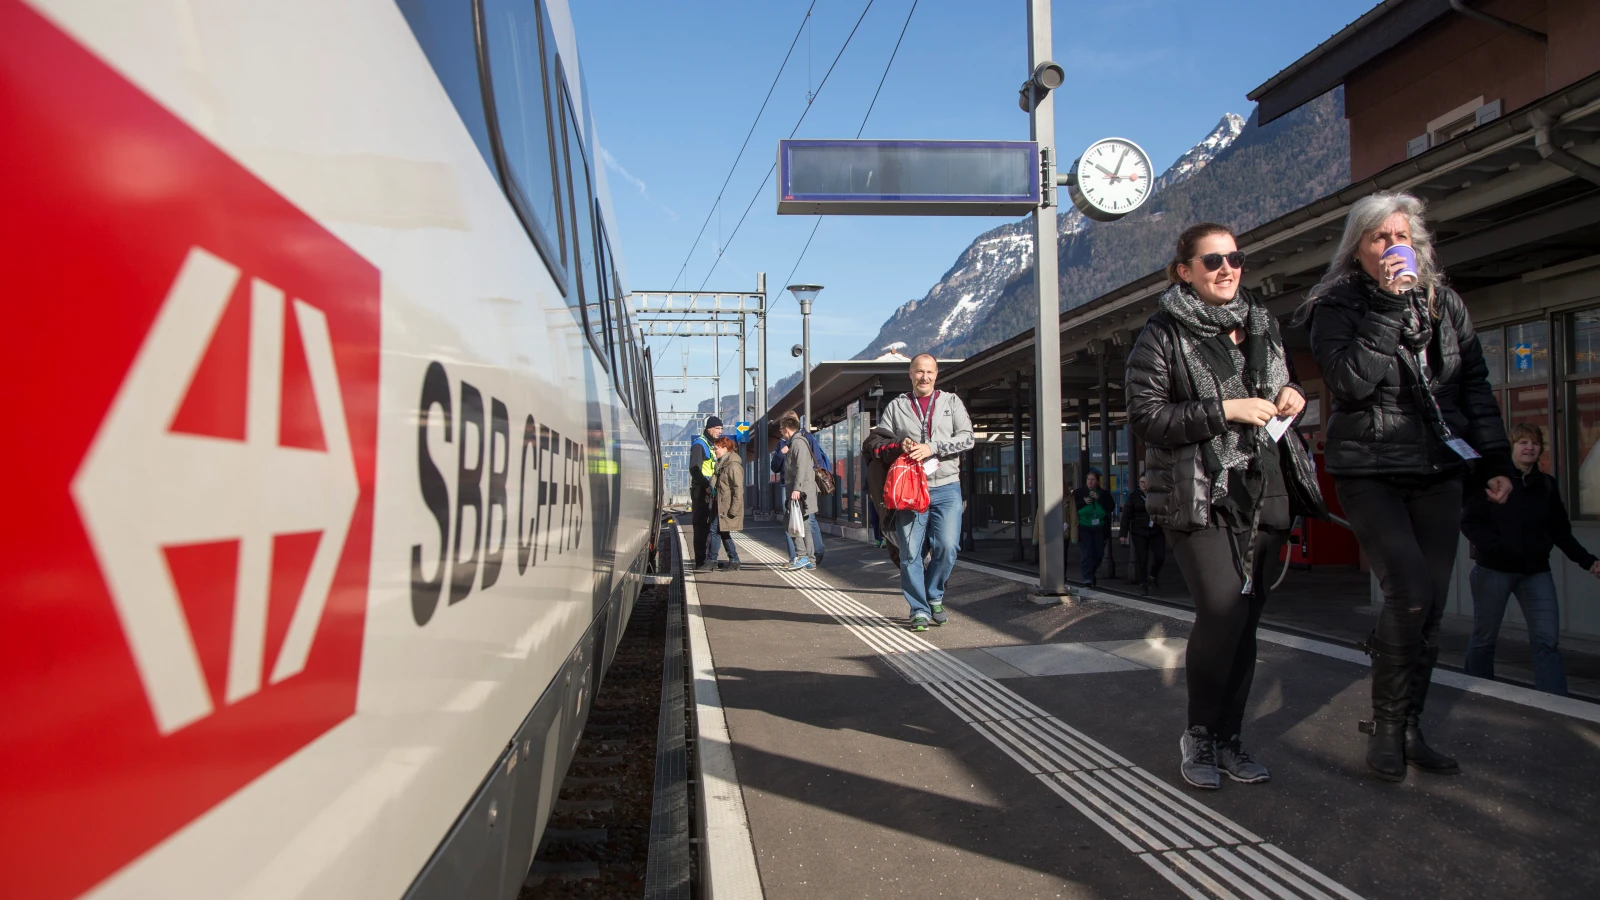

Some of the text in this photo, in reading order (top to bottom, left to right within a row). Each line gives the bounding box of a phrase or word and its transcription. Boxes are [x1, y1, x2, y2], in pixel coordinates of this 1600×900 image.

[410, 361, 585, 627] SBB CFF FFS
